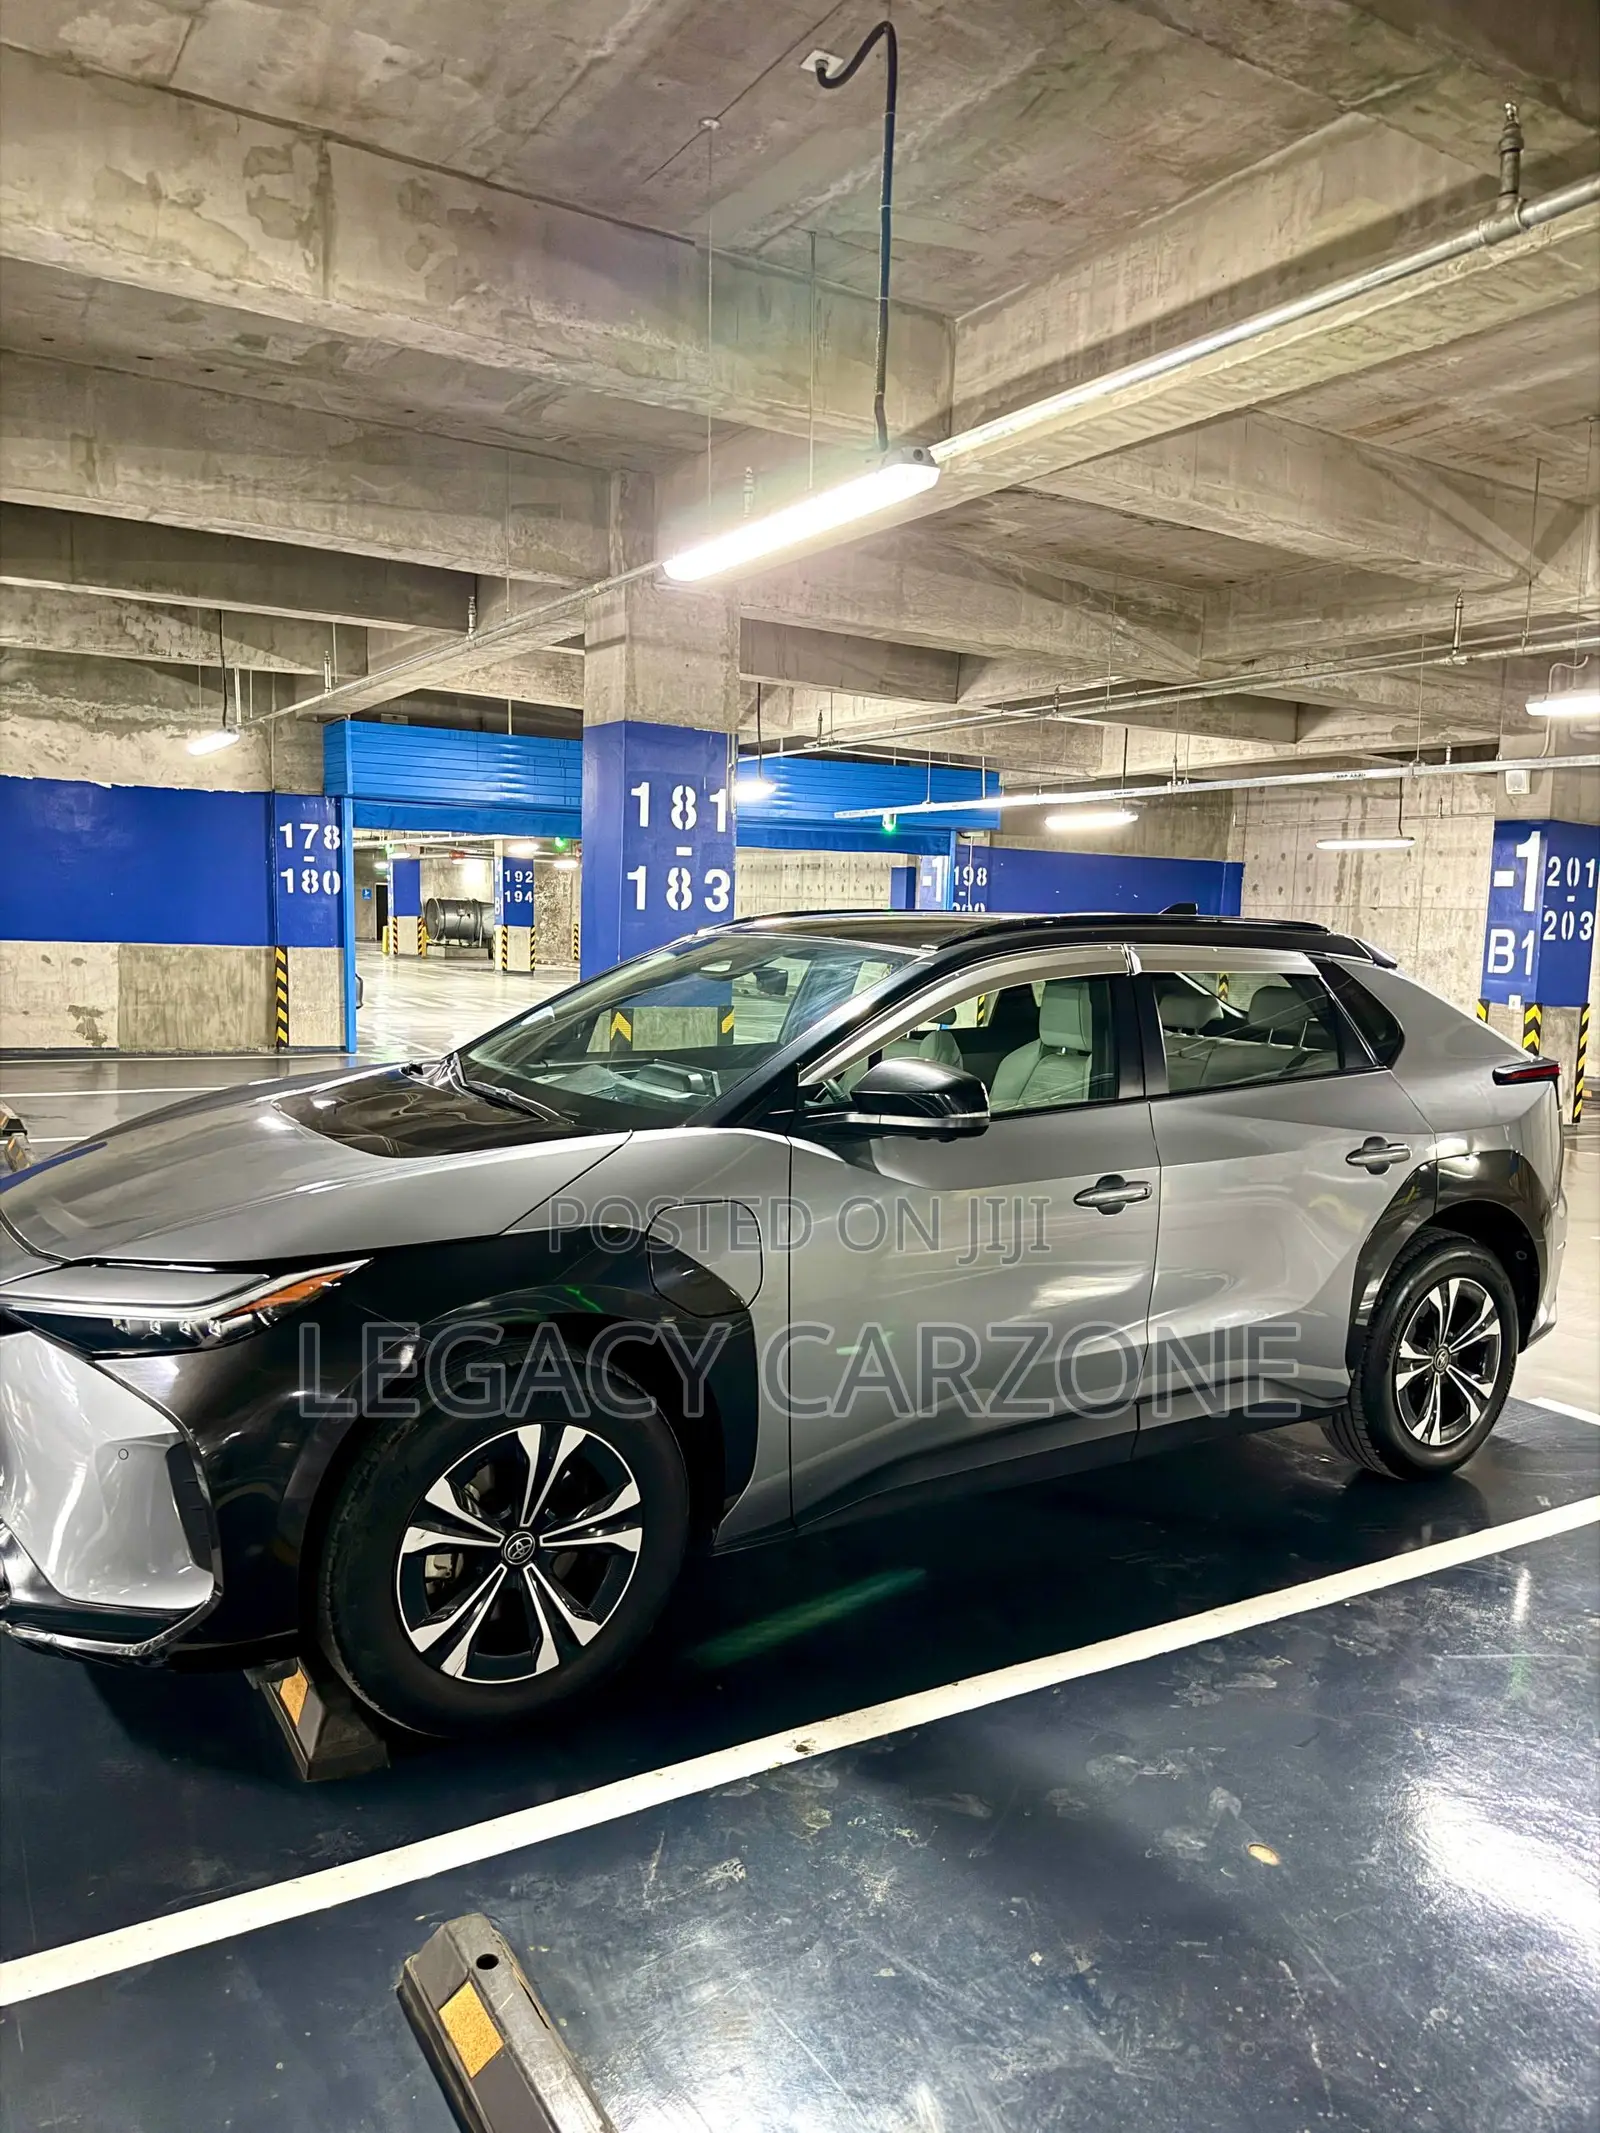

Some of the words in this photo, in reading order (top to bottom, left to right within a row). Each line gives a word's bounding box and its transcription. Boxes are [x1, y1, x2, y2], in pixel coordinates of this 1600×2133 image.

[630, 781, 727, 833] 181
[279, 822, 341, 850] 178
[280, 868, 341, 895] 180
[504, 869, 534, 883] 192
[953, 865, 988, 887] 198
[1493, 830, 1541, 912] -1
[1546, 855, 1596, 888] 201
[504, 890, 533, 903] 194
[626, 865, 731, 913] 183
[1542, 910, 1594, 941] 203
[1487, 928, 1535, 976] B1
